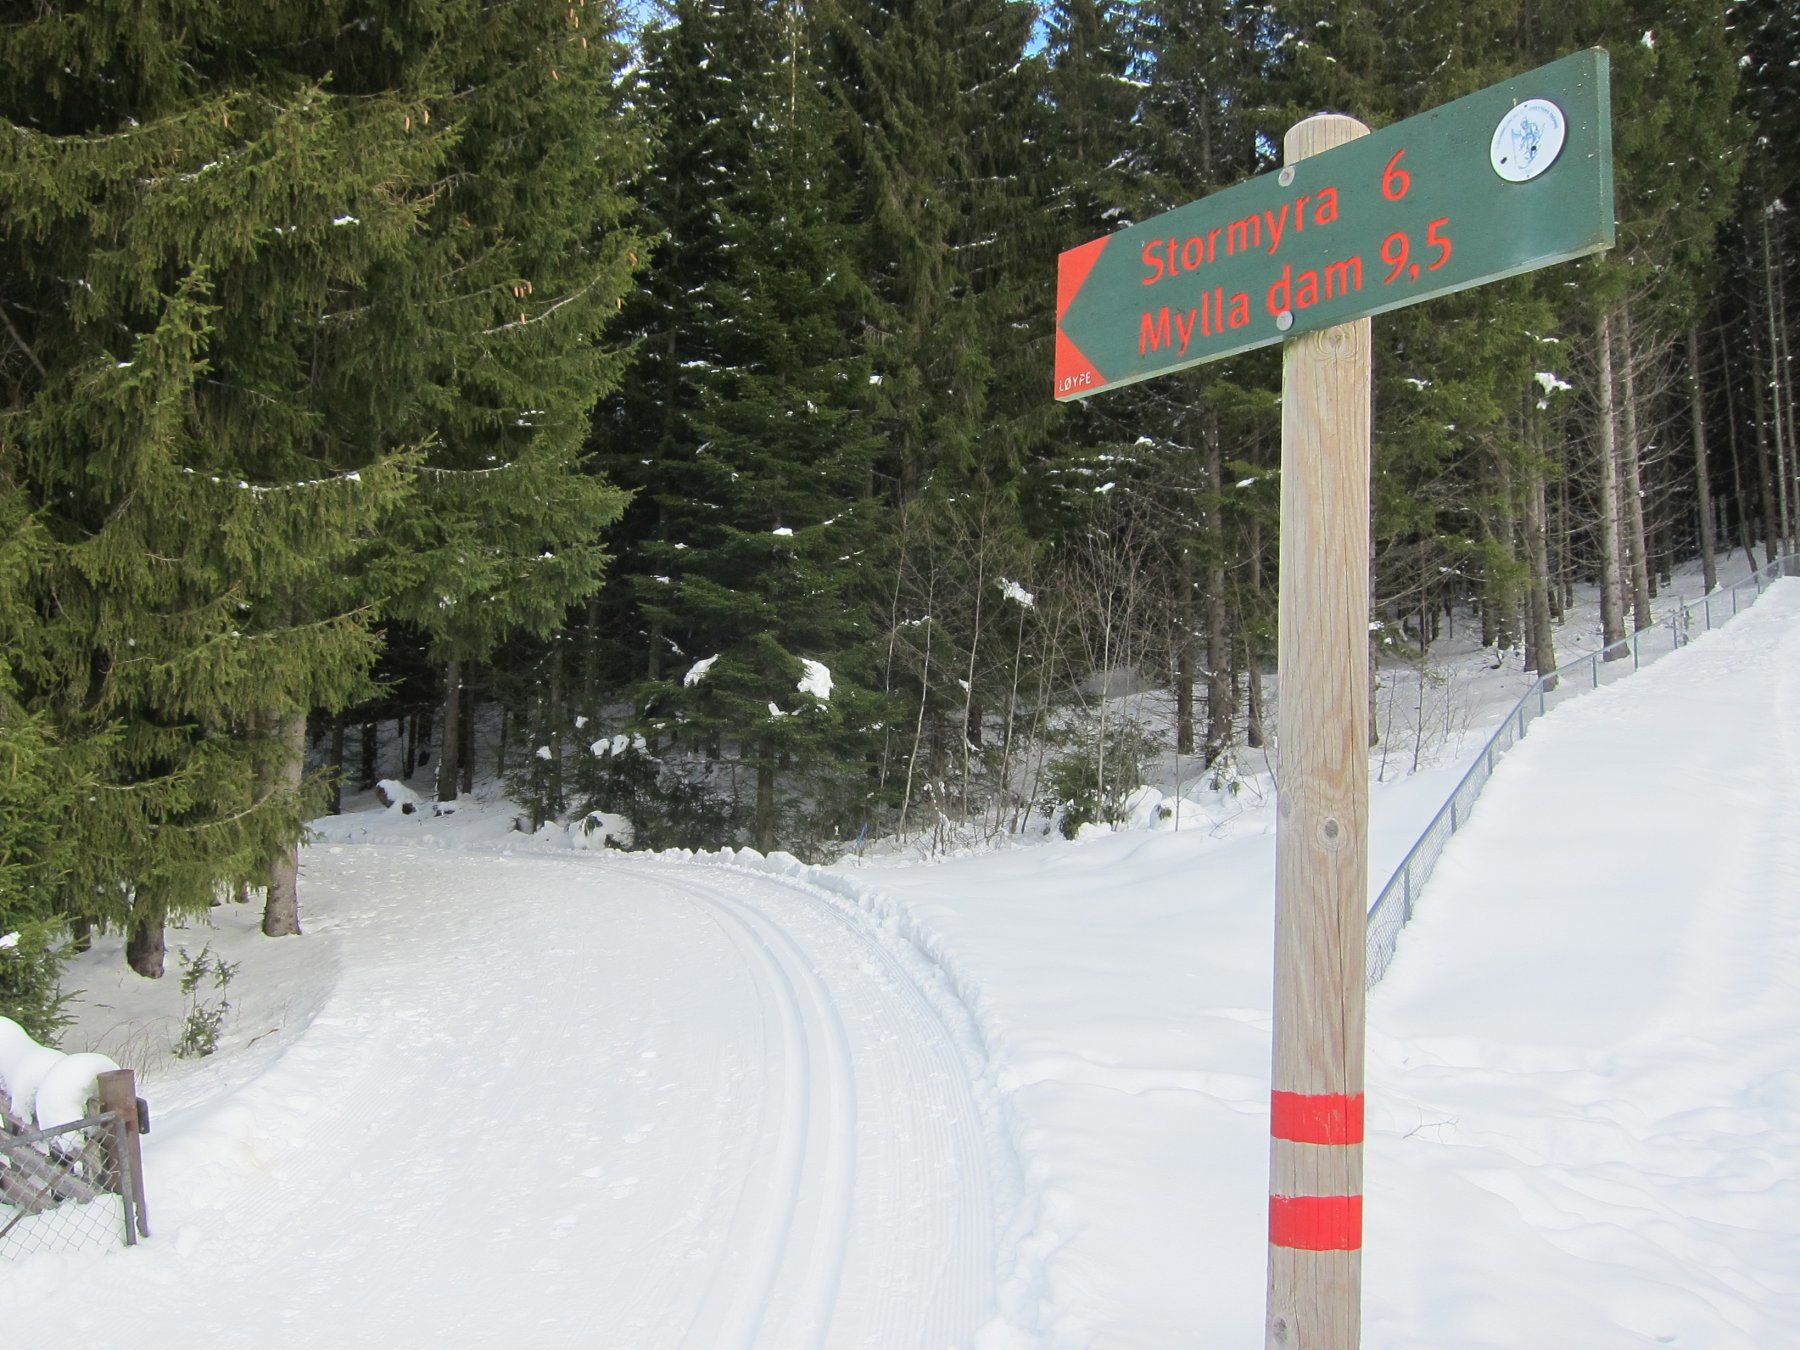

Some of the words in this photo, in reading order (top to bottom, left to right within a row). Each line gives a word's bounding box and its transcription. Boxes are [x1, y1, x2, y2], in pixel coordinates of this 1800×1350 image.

[1141, 187, 1339, 285] Stormyra
[1381, 149, 1411, 201] 6
[1138, 287, 1250, 356] Mylla
[1266, 255, 1363, 317] dam
[1380, 217, 1452, 281] 9,5
